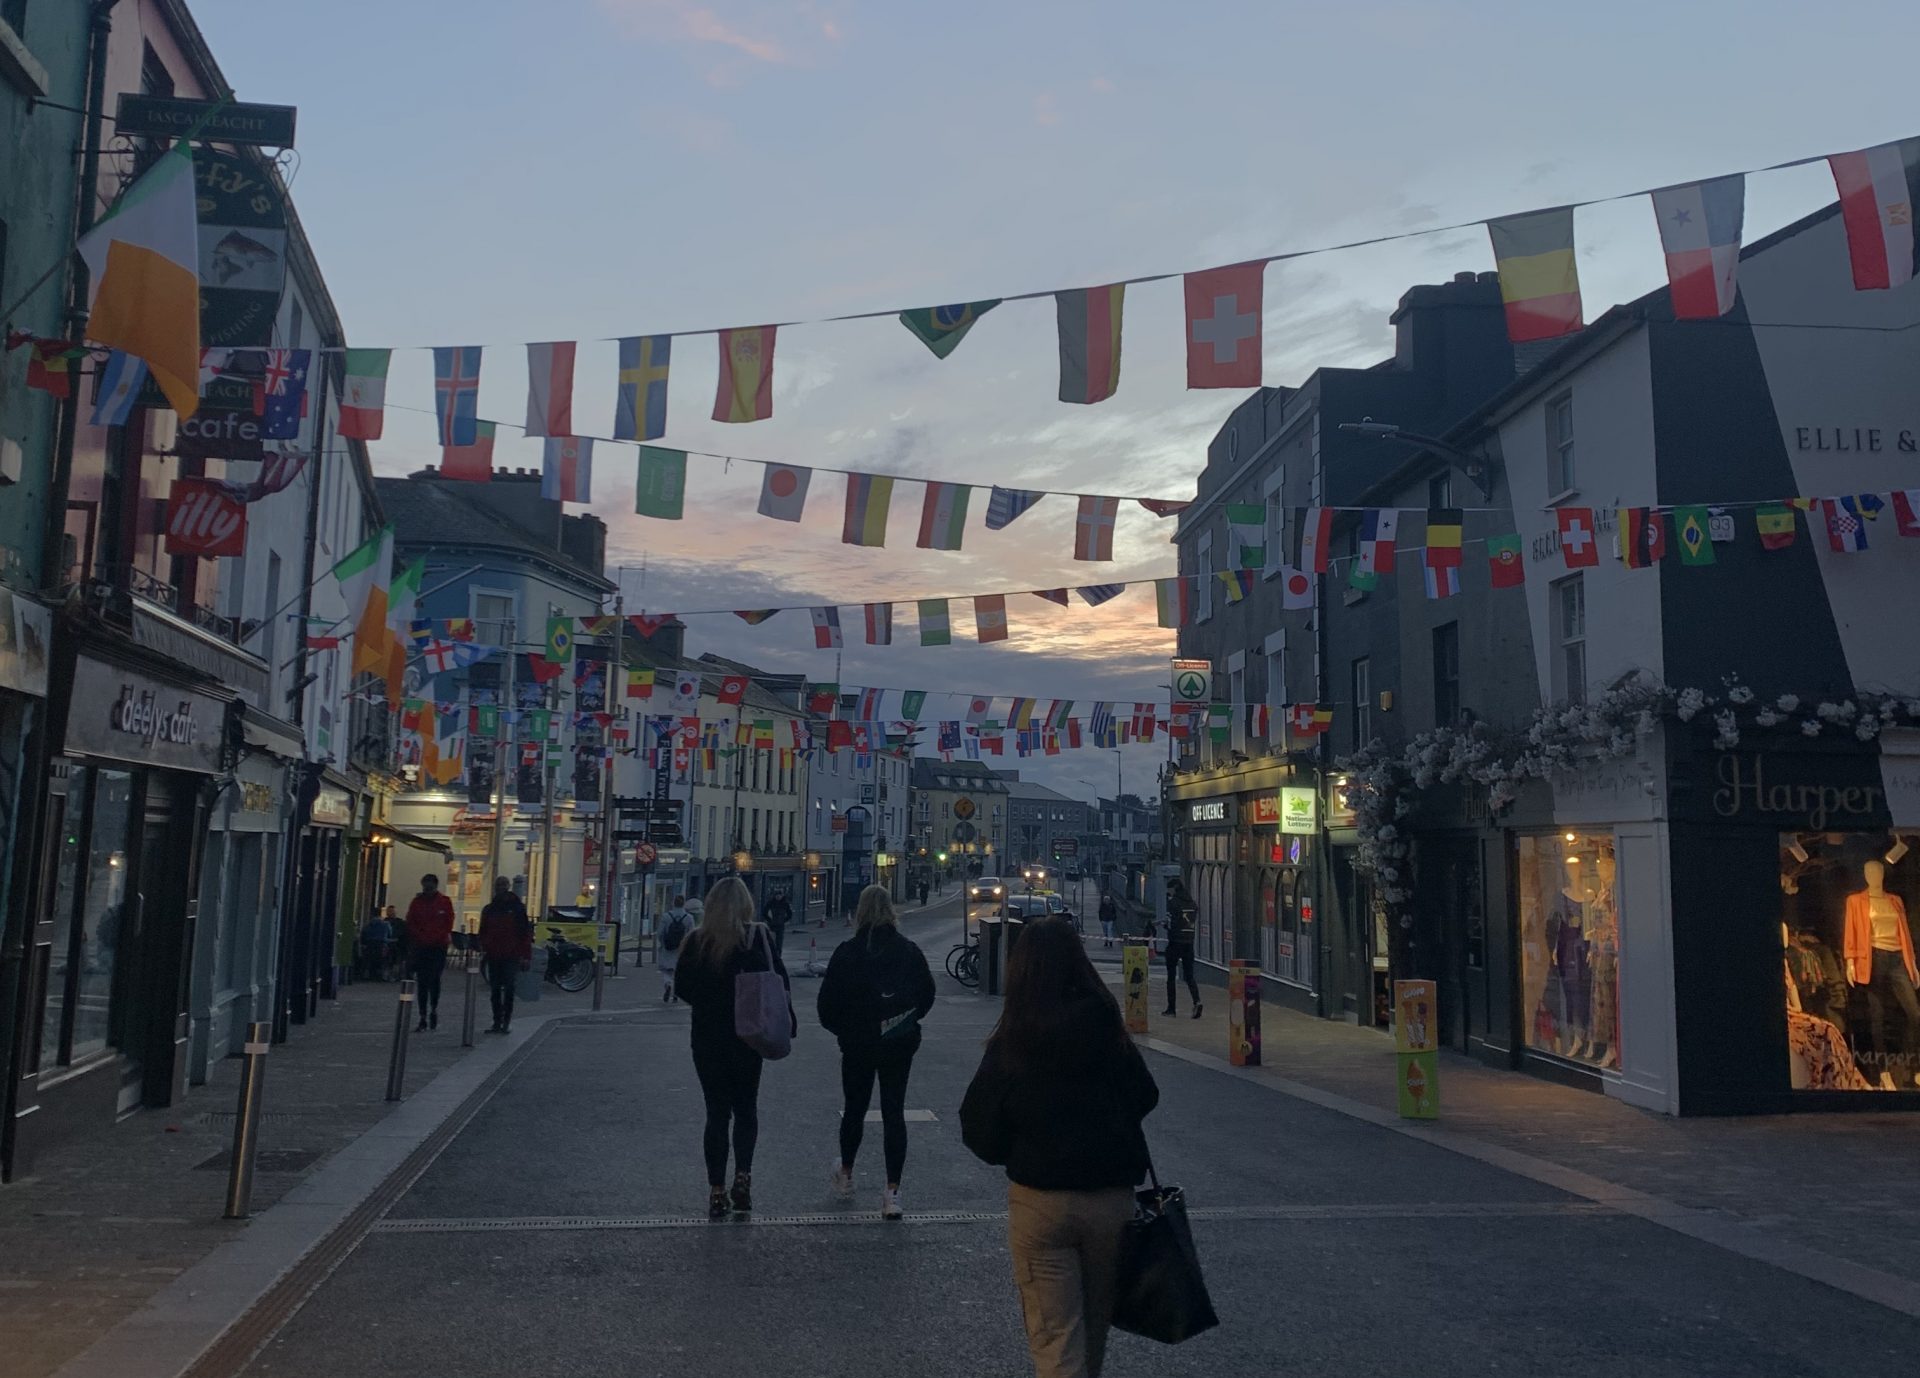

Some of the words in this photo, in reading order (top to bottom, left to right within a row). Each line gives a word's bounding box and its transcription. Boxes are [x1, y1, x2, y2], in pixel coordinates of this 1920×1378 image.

[181, 412, 259, 440] cafe
[1795, 427, 1882, 452] ELLIE
[1897, 429, 1918, 452] &
[170, 490, 241, 548] illy
[1713, 753, 1883, 830] Harper
[1192, 805, 1202, 821] OFF
[1203, 802, 1225, 820] LICENCE
[1260, 796, 1281, 817] SPA
